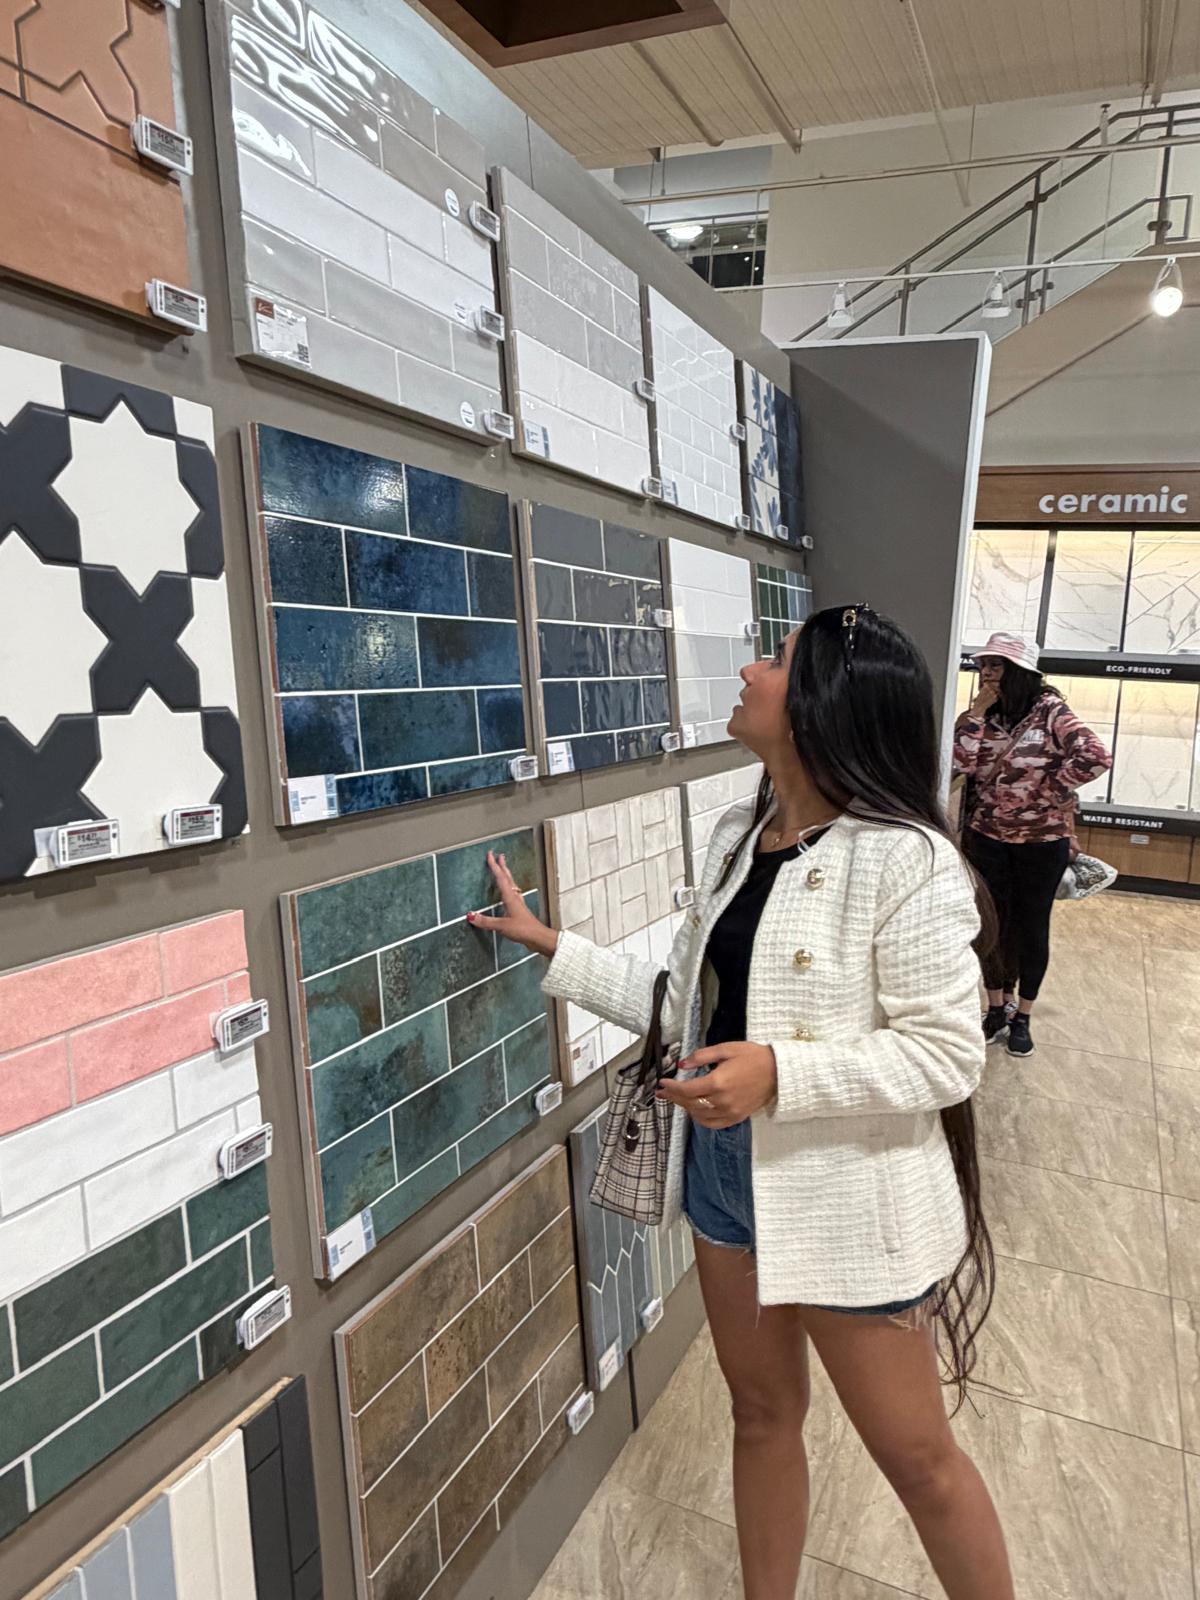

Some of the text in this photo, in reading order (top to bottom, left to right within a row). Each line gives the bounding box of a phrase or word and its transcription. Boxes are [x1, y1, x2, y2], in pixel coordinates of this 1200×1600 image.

[1039, 485, 1189, 514] ceramic
[1106, 664, 1172, 675] ECO-FRIENDLY
[1083, 814, 1163, 828] WATER RESISTANT
